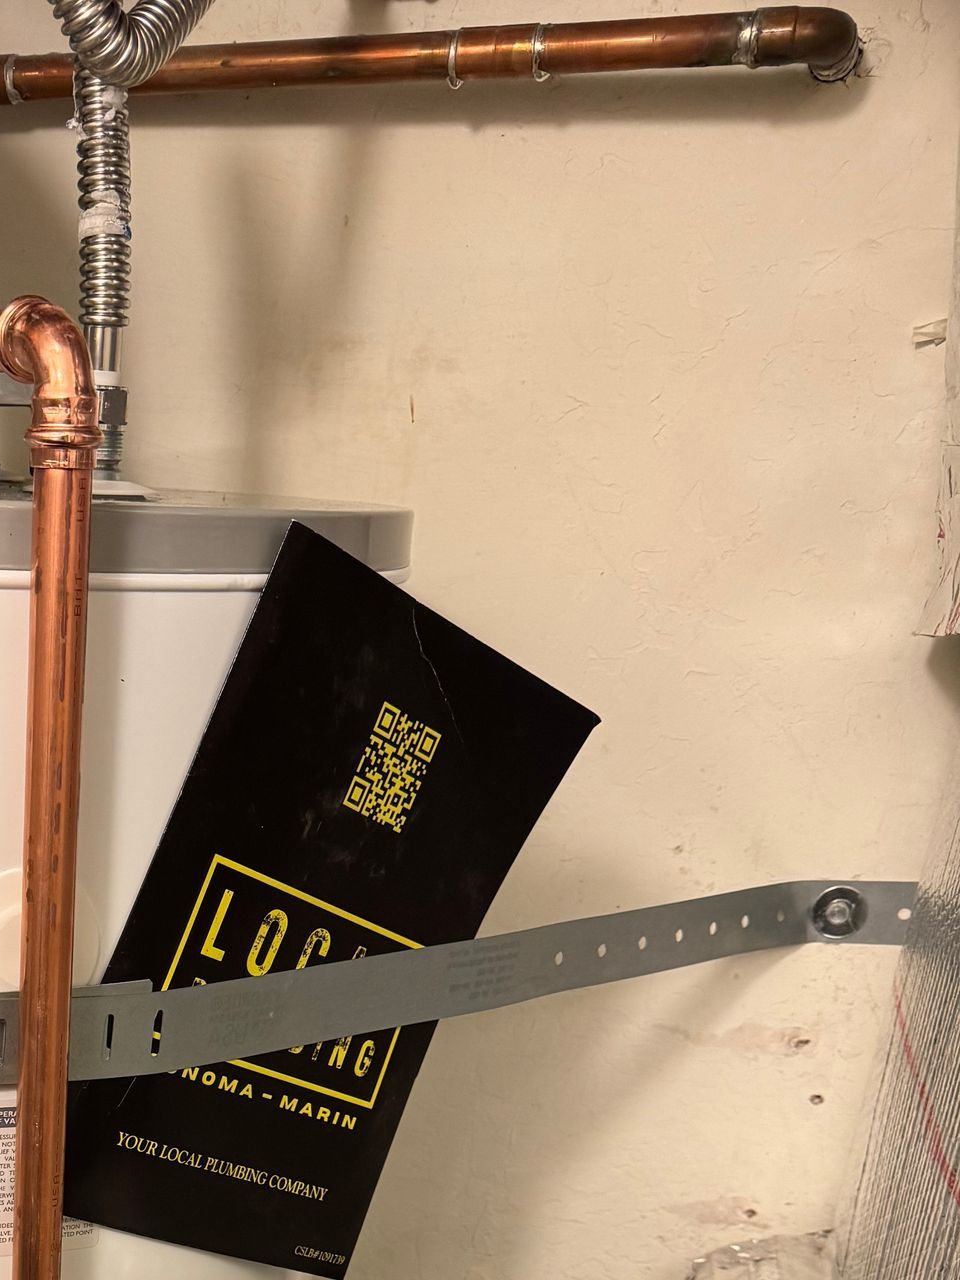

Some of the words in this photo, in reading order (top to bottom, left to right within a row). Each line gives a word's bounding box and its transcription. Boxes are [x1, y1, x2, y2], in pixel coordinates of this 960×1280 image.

[200, 889, 367, 977] LOC
[279, 1095, 357, 1130] MARIN
[117, 1131, 158, 1157] YOUR
[159, 1144, 202, 1169] LOCAL
[204, 1156, 268, 1185] PLUMBING
[269, 1174, 328, 1200] COMPANY
